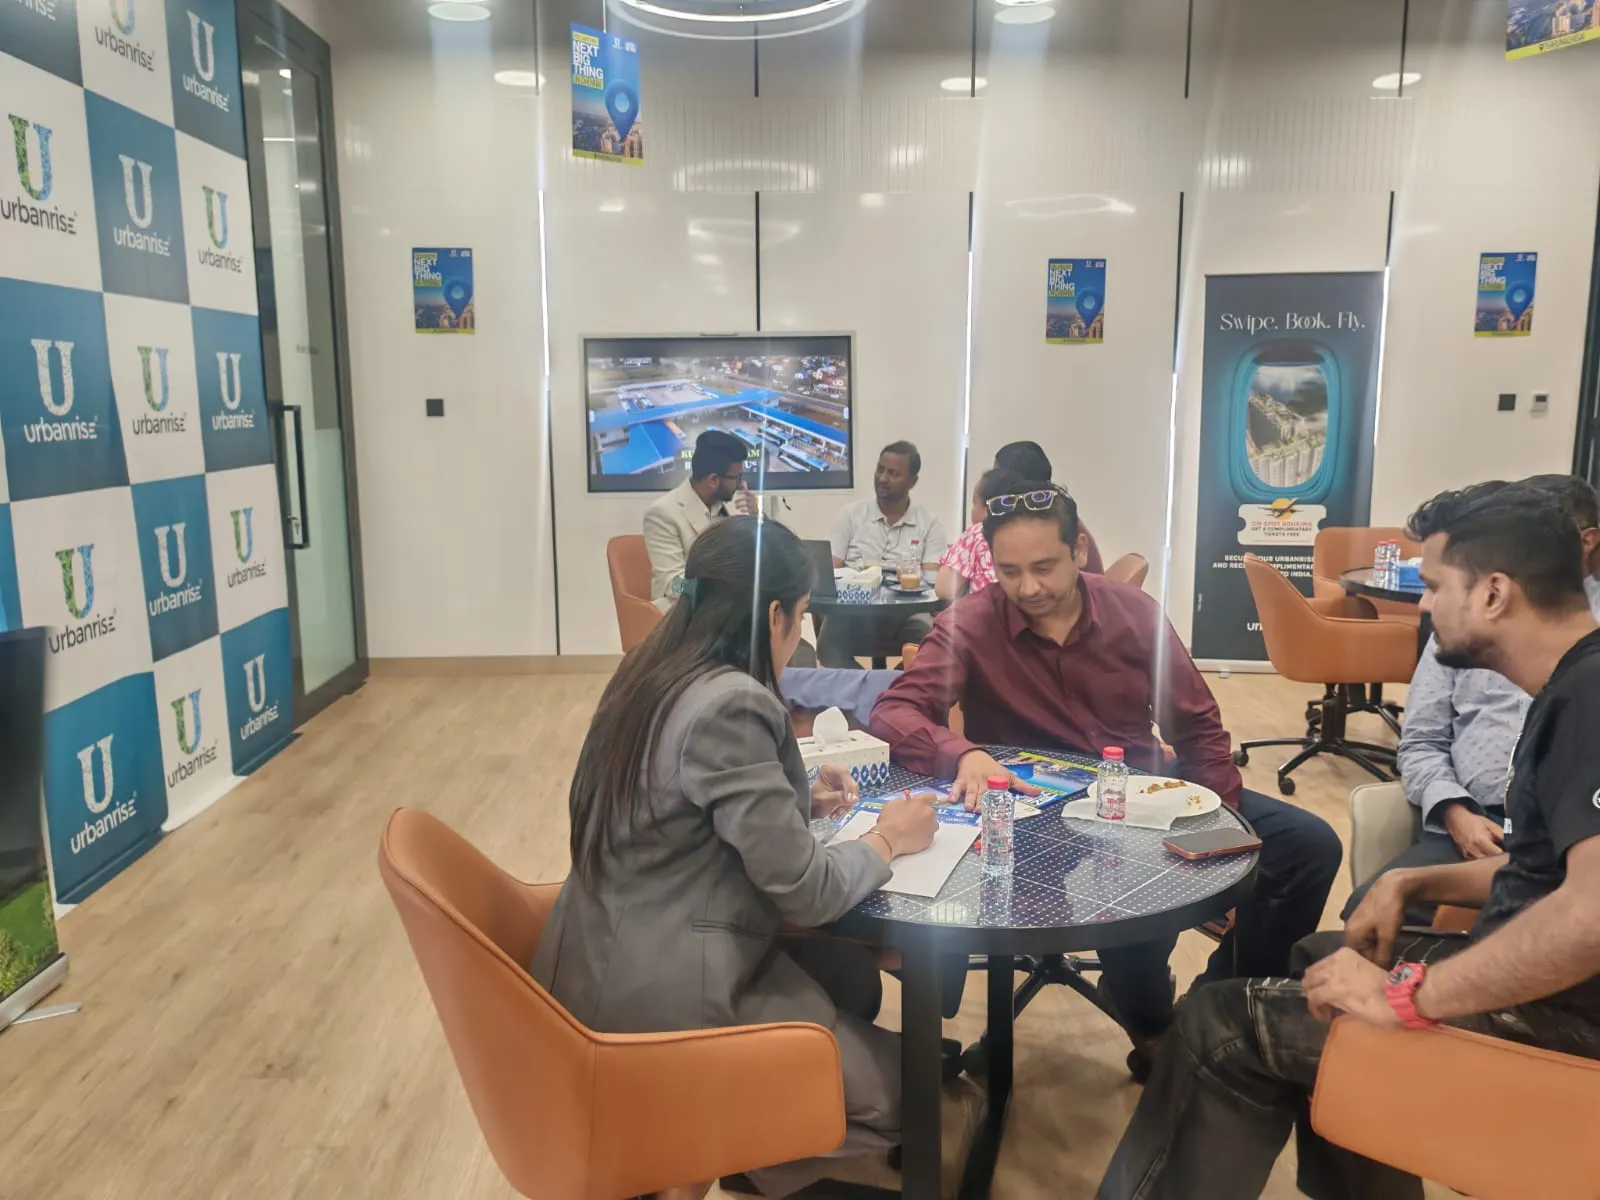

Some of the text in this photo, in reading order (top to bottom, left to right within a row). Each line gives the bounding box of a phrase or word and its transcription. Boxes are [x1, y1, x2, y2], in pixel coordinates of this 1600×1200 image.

[573, 40, 599, 57] NEXT
[573, 52, 590, 66] BIG
[573, 63, 603, 80] THING
[1220, 311, 1366, 336] Swipe. Book. Fly.
